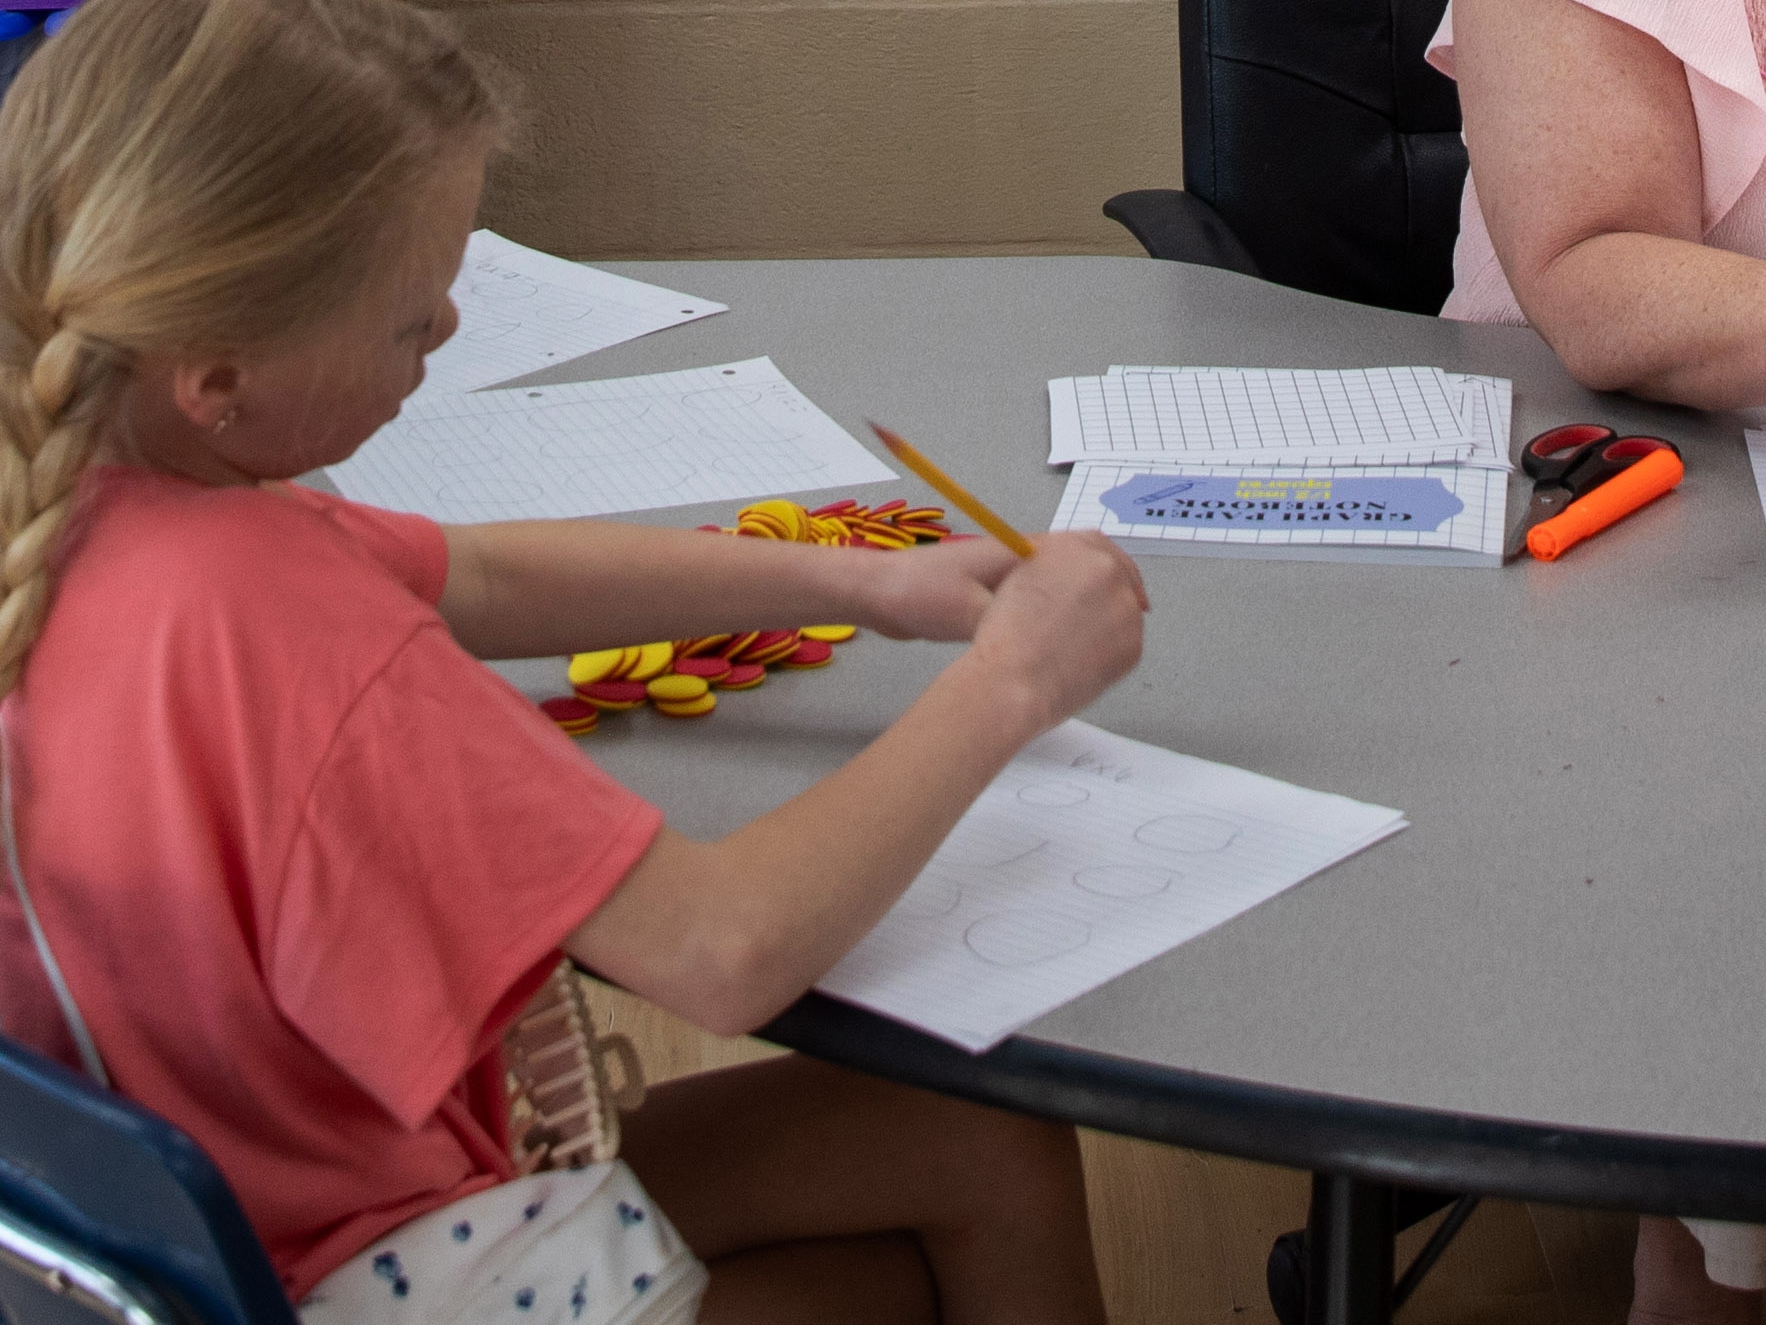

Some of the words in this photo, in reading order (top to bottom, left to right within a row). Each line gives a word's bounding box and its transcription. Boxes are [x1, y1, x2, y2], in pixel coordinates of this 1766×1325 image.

[1173, 498, 1387, 511] NOTEBOOK
[1144, 507, 1265, 521] PAPER
[1283, 511, 1412, 523] GRAPH
